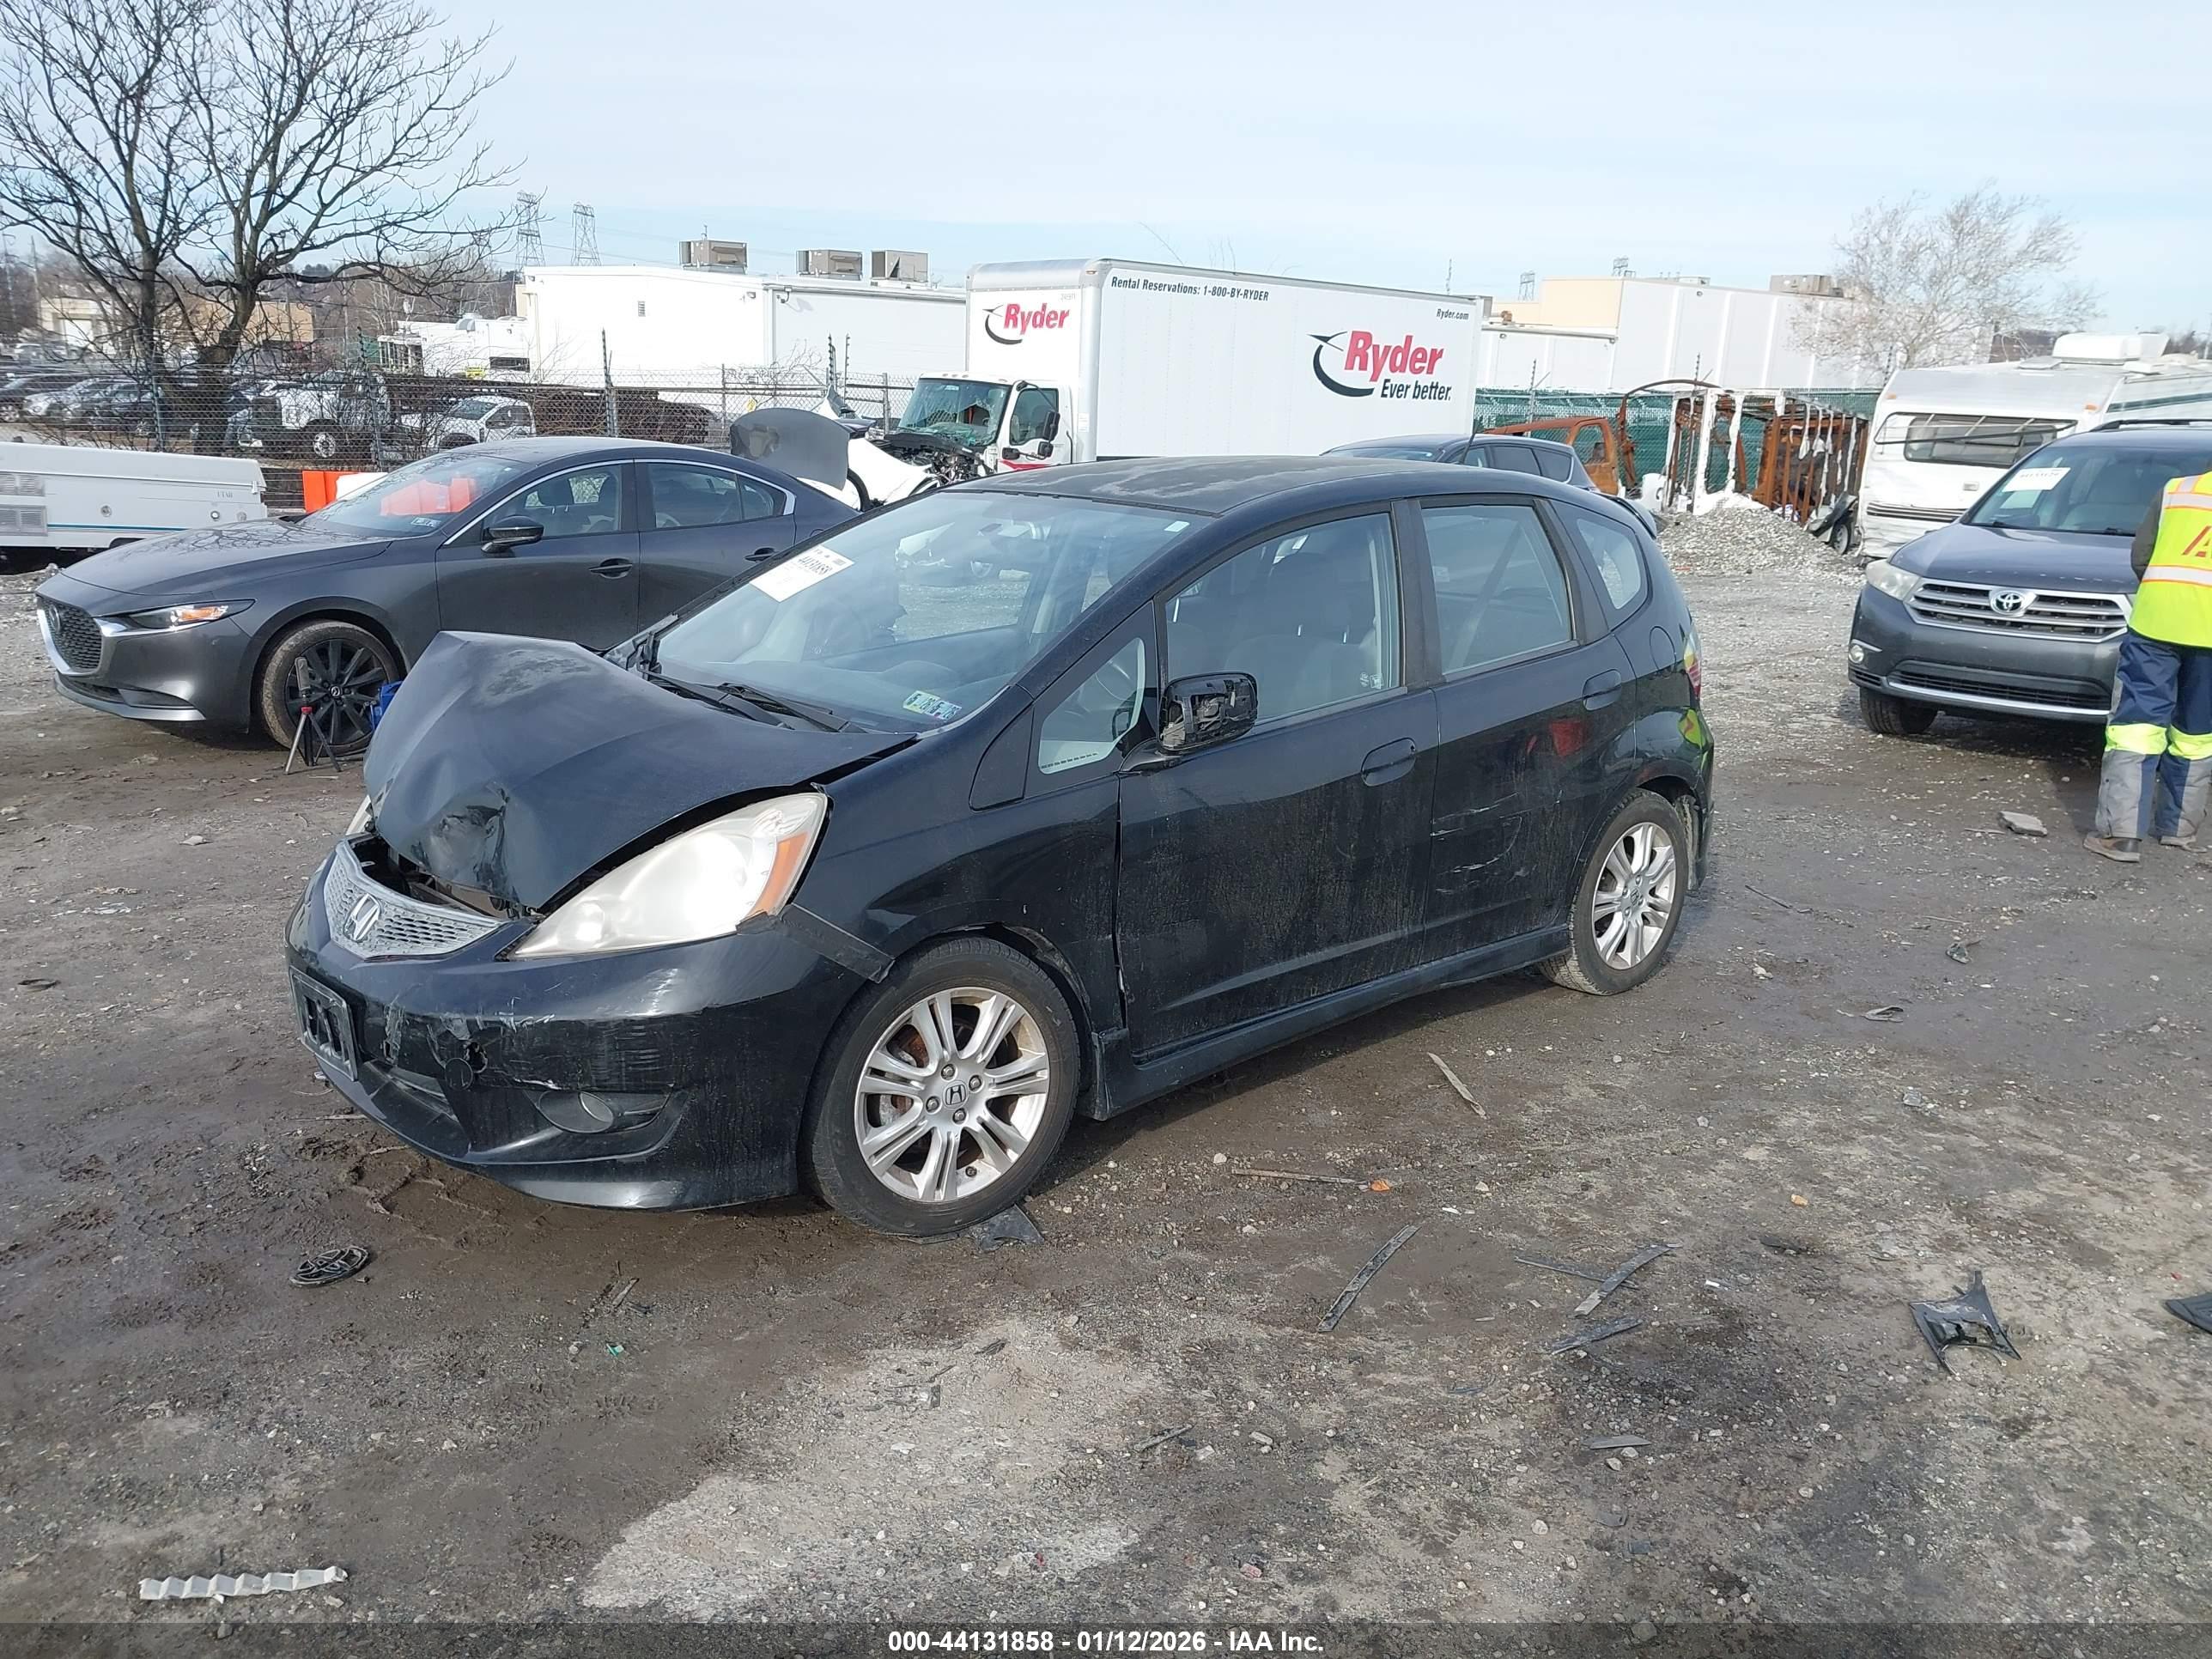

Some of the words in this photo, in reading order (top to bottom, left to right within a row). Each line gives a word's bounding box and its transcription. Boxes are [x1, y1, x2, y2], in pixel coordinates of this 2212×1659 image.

[1111, 276, 1139, 289] Rental
[1142, 278, 1200, 295] Reservations:
[1203, 285, 1269, 301] 1-800-BY-RYDER
[1004, 302, 1070, 336] Ryder
[1436, 308, 1469, 320] Ryder.com
[1344, 330, 1444, 382] Ryder
[1380, 379, 1411, 400] Ever
[1412, 380, 1451, 401] better.
